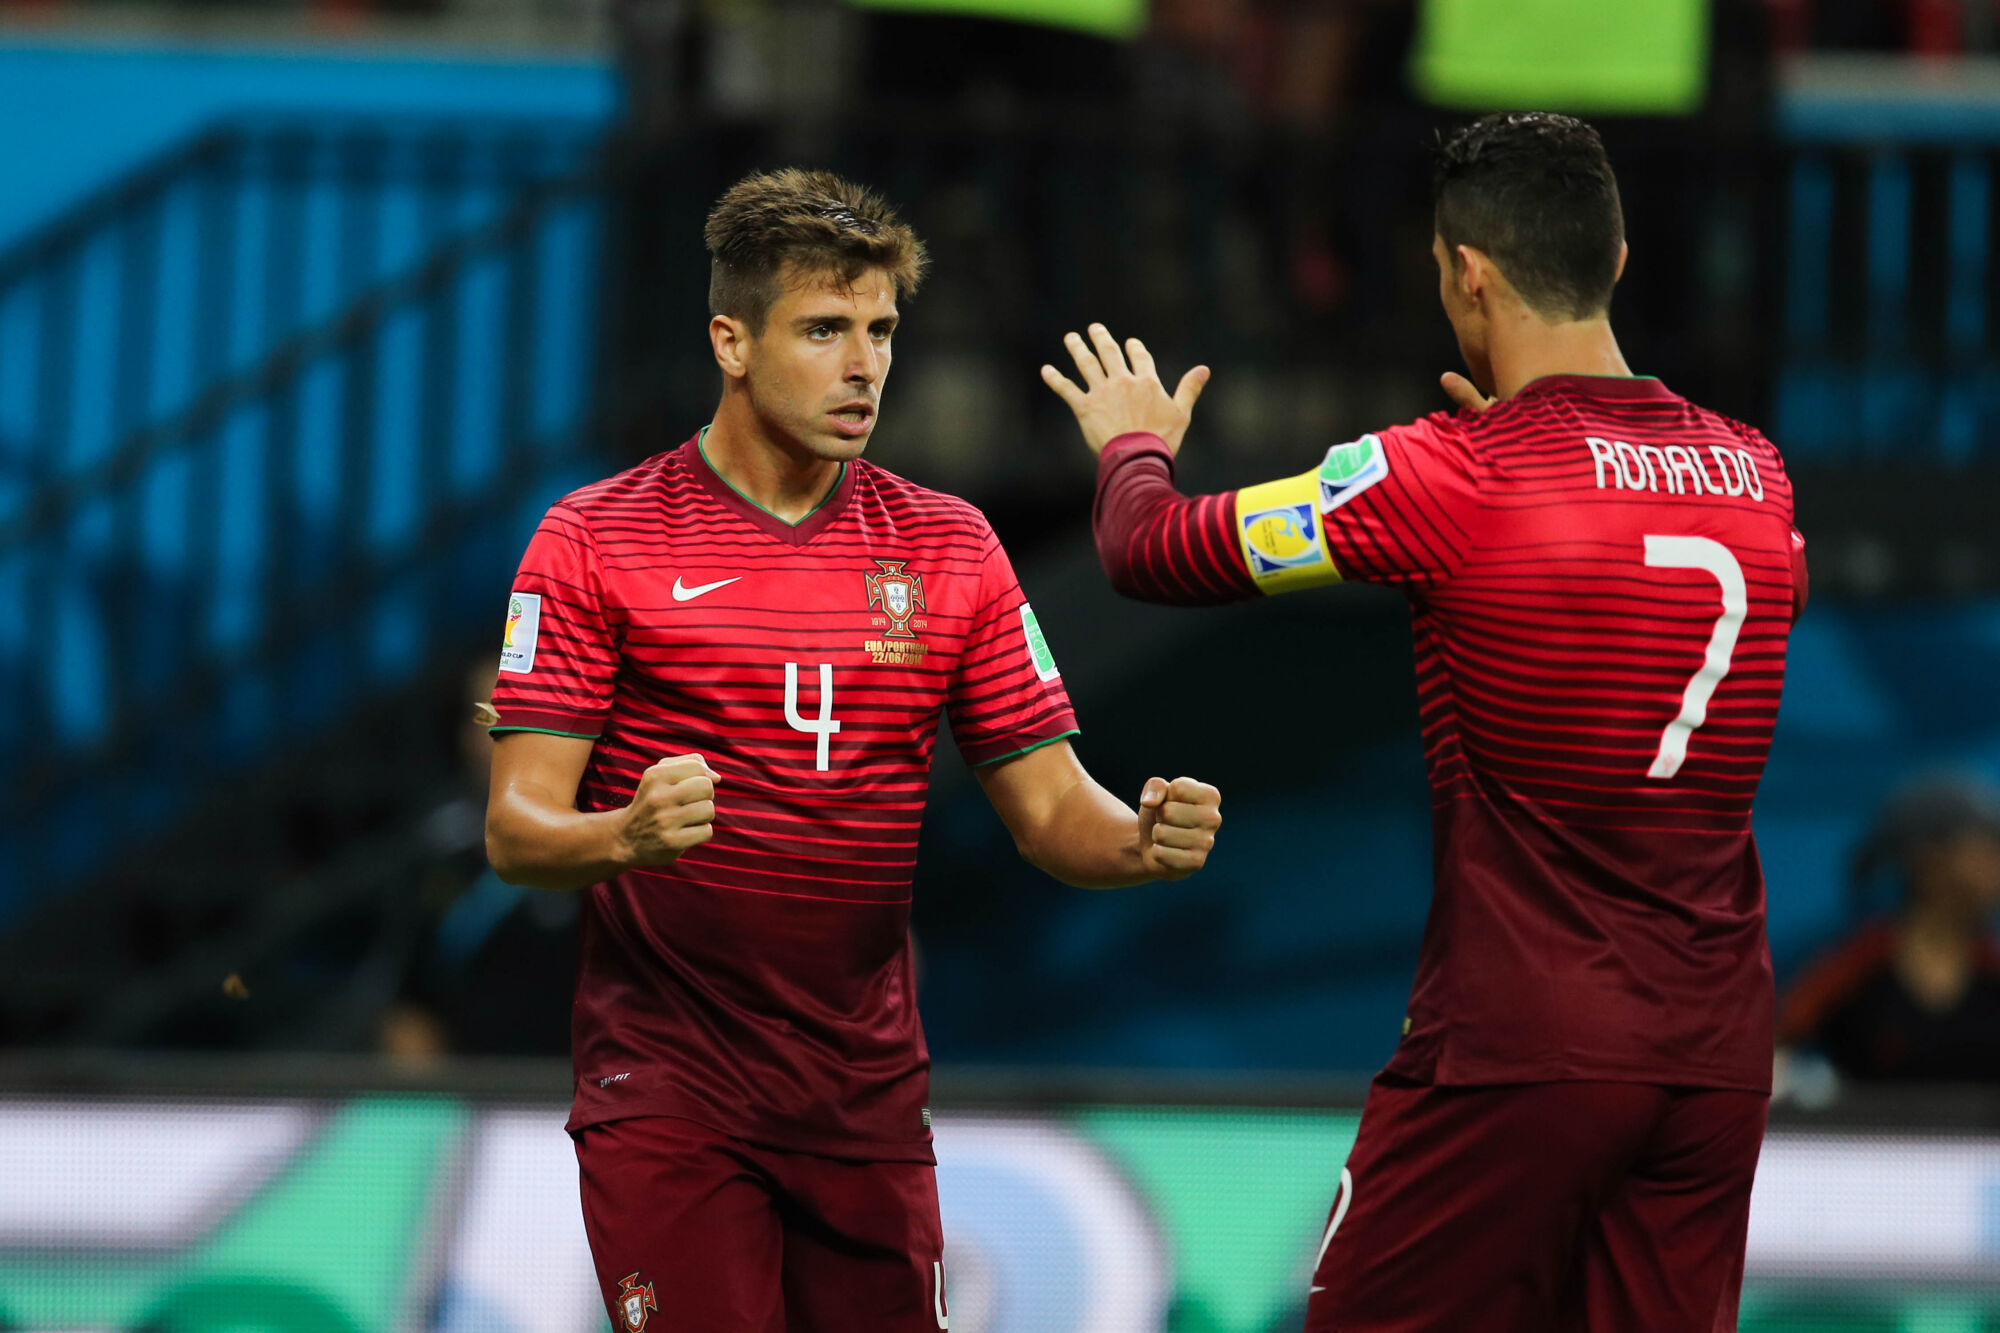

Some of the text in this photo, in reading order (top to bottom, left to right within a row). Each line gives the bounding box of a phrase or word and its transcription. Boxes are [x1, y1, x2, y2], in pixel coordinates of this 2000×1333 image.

[1585, 437, 1764, 502] RONALDO
[864, 640, 929, 655] EUA/PORTUGAL
[872, 652, 922, 666] 22/06/2014
[1643, 534, 1748, 779] 7
[784, 662, 841, 771] 4
